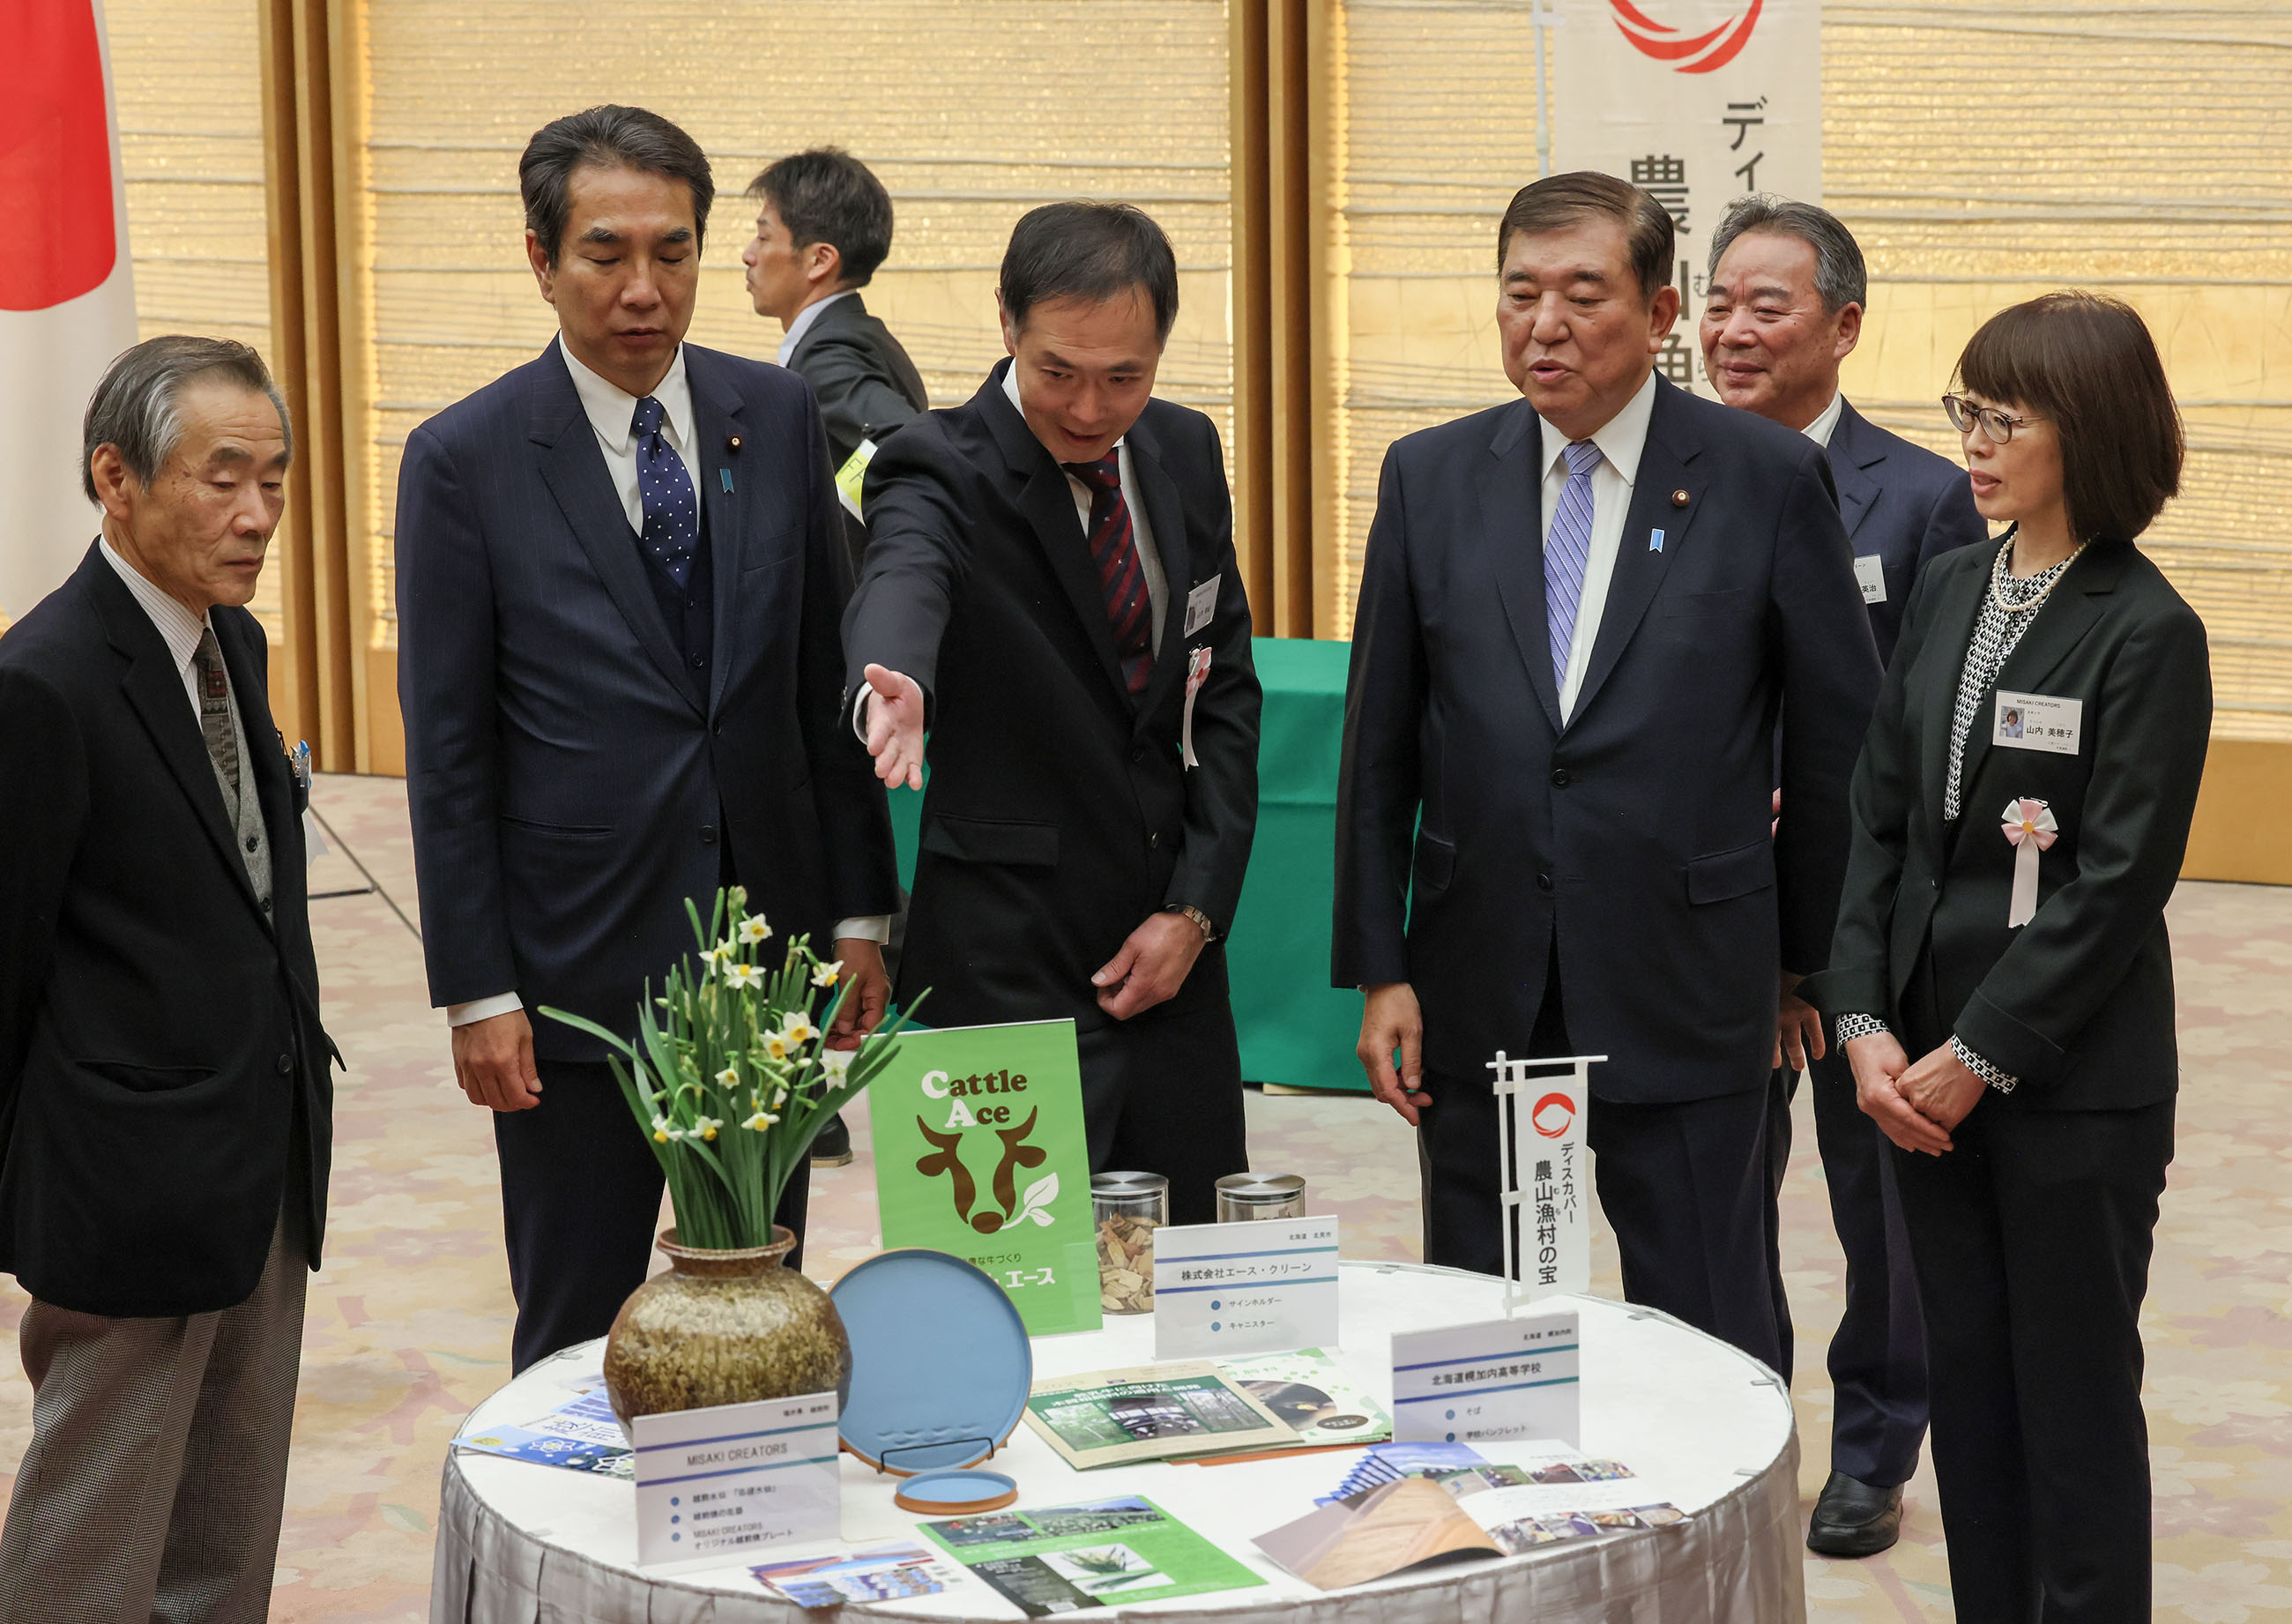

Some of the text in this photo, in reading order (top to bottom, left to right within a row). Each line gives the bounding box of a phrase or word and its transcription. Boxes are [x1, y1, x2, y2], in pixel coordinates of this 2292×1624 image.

[2026, 725, 2073, 738] 山内 美穂子
[921, 1069, 1027, 1099] Cattle
[944, 1099, 1010, 1129] Ace
[1561, 1143, 1577, 1224] ディスカバー
[1535, 1159, 1558, 1285] 農山漁村の宝
[965, 1253, 1022, 1265] 康な牛づくり
[1005, 1267, 1056, 1288] エース
[1181, 1263, 1312, 1282] 株式会社エース・クリーン
[1229, 1297, 1283, 1307] サインホルダー
[1229, 1319, 1275, 1330] キャニスター
[1432, 1362, 1542, 1386] 北海道幌加内高等学校
[1467, 1425, 1526, 1438] 学校パンフレット
[687, 1442, 788, 1466] MISAKI CREATORS
[693, 1522, 763, 1538] MISAKI CREATORS
